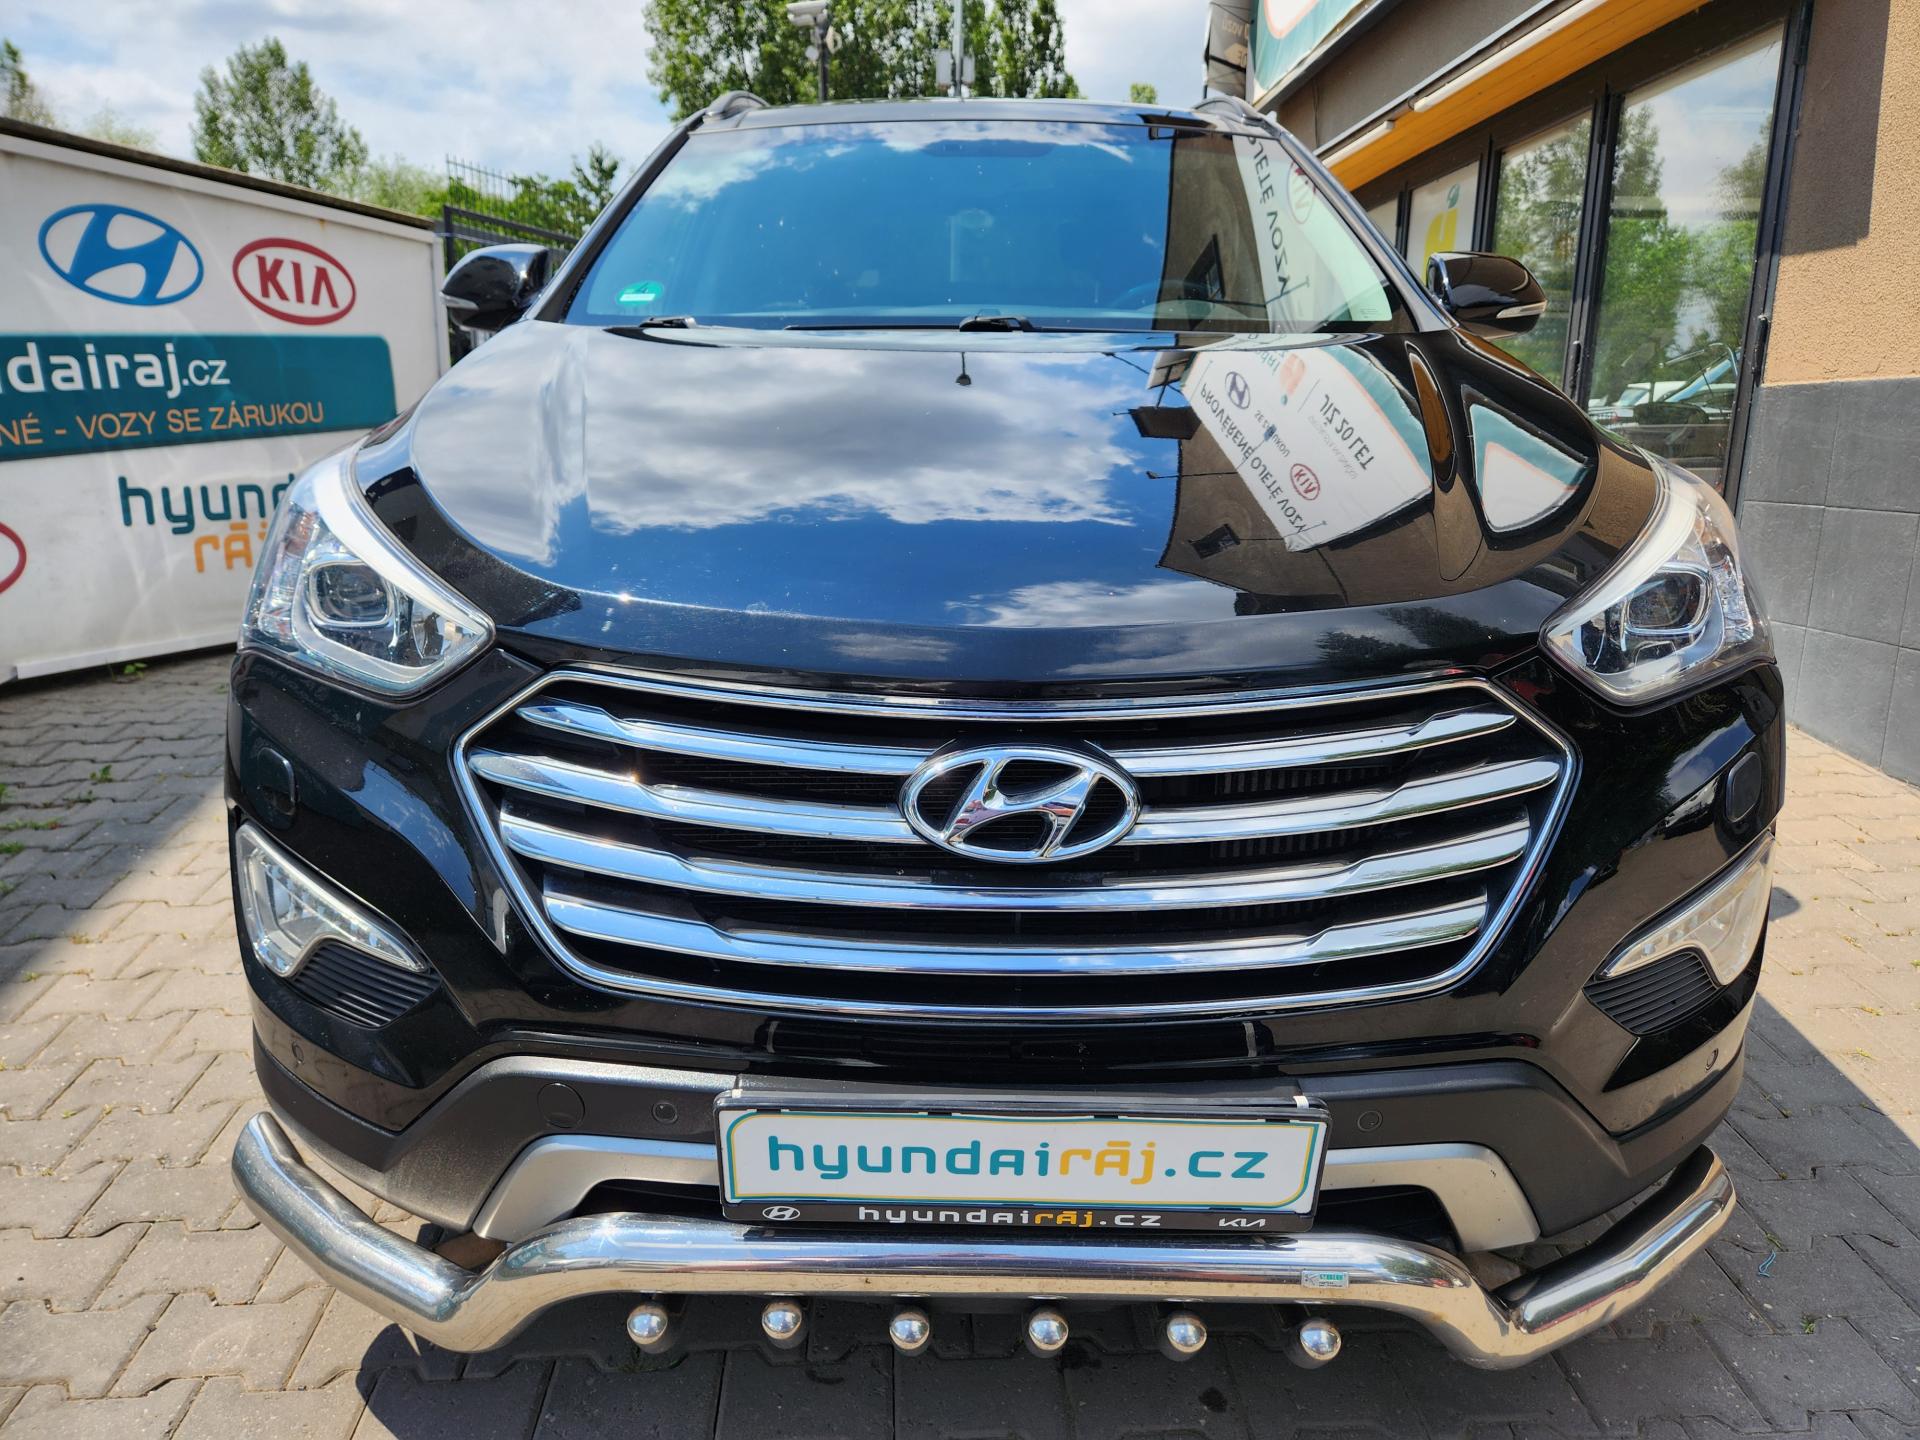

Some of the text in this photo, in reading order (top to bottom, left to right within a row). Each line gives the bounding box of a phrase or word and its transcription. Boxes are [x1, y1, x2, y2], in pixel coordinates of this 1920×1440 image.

[255, 254, 339, 309] KIA
[0, 341, 230, 400] dairaj.cz
[76, 411, 156, 440] VOZY
[167, 408, 203, 433] SE
[209, 401, 325, 431] ZÁRUKOU
